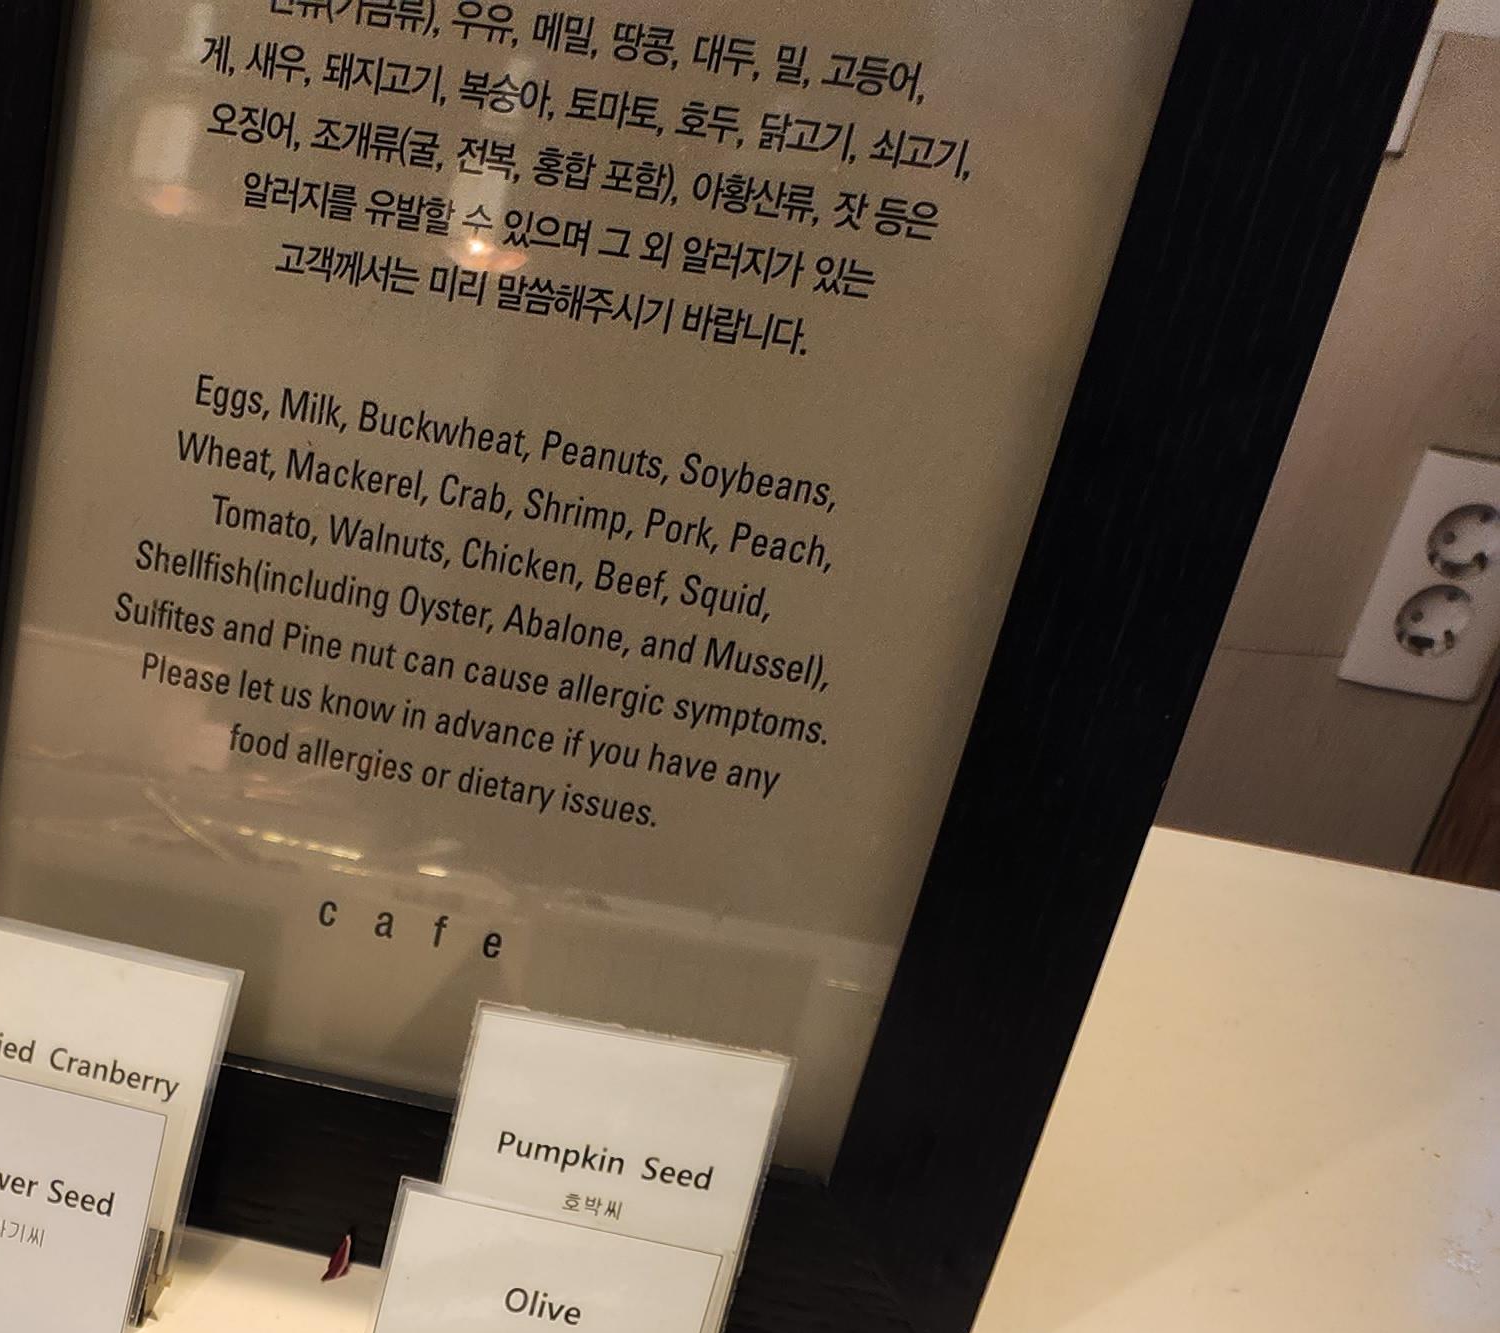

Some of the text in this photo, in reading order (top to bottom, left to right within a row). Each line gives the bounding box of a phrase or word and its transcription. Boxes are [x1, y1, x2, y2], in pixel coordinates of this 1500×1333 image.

[200, 34, 971, 182] 게, 새우, 돼지고기, 복숭아, 토마토, 호두, 닭고기, 쇠고기,
[451, 0, 519, 49] 우유,
[531, 11, 598, 60] 메밀,
[613, 21, 679, 72] 땅콩,
[692, 33, 760, 83] 대두,
[775, 44, 810, 90] 밀,
[820, 53, 925, 106] 고등어,
[206, 102, 939, 241] 오징어, 조개류(굴, 전복, 홍합 포함), 아황산류, 잣 등은
[243, 171, 877, 300] 알러지를 유발할 수 있으며 그 외 알러지가 있는
[274, 242, 807, 357] 고객께서는 미리 말씀해주시기 바랍니다.
[177, 429, 832, 575] Wheat, Mackerel, Crab, Shrimp, Pork, Peach,
[195, 373, 836, 514] Eggs, Milk, Buckwheat, Peanuts, Soybeans,
[135, 539, 829, 693] Shellfish(including Oyster, Abalone, and Mussel),
[212, 493, 771, 624] Tomato, Walnuts, Chicken, Beef, Squid,
[141, 652, 781, 800] Please let us know in advance if you have any
[223, 618, 275, 648] and
[282, 621, 342, 660] Pine
[350, 641, 397, 670] nut
[403, 651, 455, 680] can
[463, 661, 549, 696] cause
[557, 671, 665, 719] allergic
[673, 698, 827, 746] symptoms.
[229, 722, 657, 828] food allergies or dietary issues.
[49, 1047, 180, 1103] Cranberry
[46, 1179, 116, 1218] Seed
[497, 1130, 715, 1191] Pumpkin Seed
[561, 1192, 623, 1221] 호박씨
[504, 1287, 581, 1326] Olive
